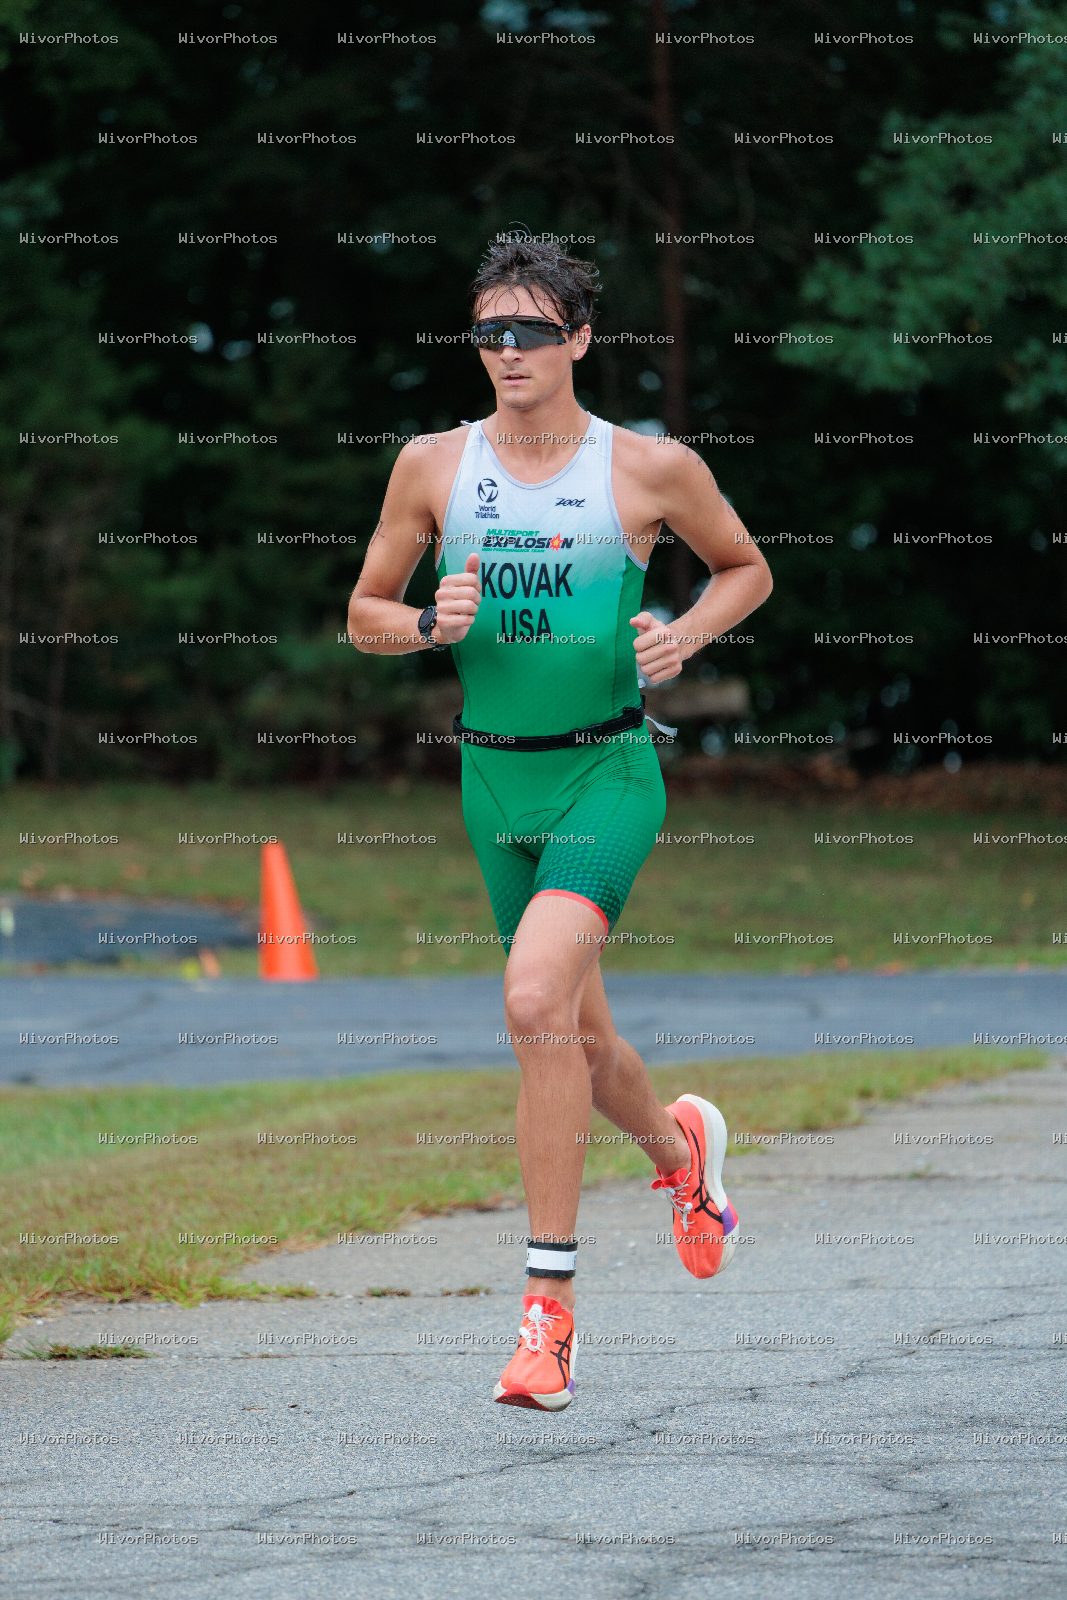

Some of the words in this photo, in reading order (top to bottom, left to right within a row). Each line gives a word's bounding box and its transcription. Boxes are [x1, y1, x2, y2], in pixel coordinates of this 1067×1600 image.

[482, 535, 575, 549] EXPLOSIN
[486, 528, 540, 537] MULTISPORT
[481, 562, 573, 599] KOVAK
[501, 608, 553, 642] USA
